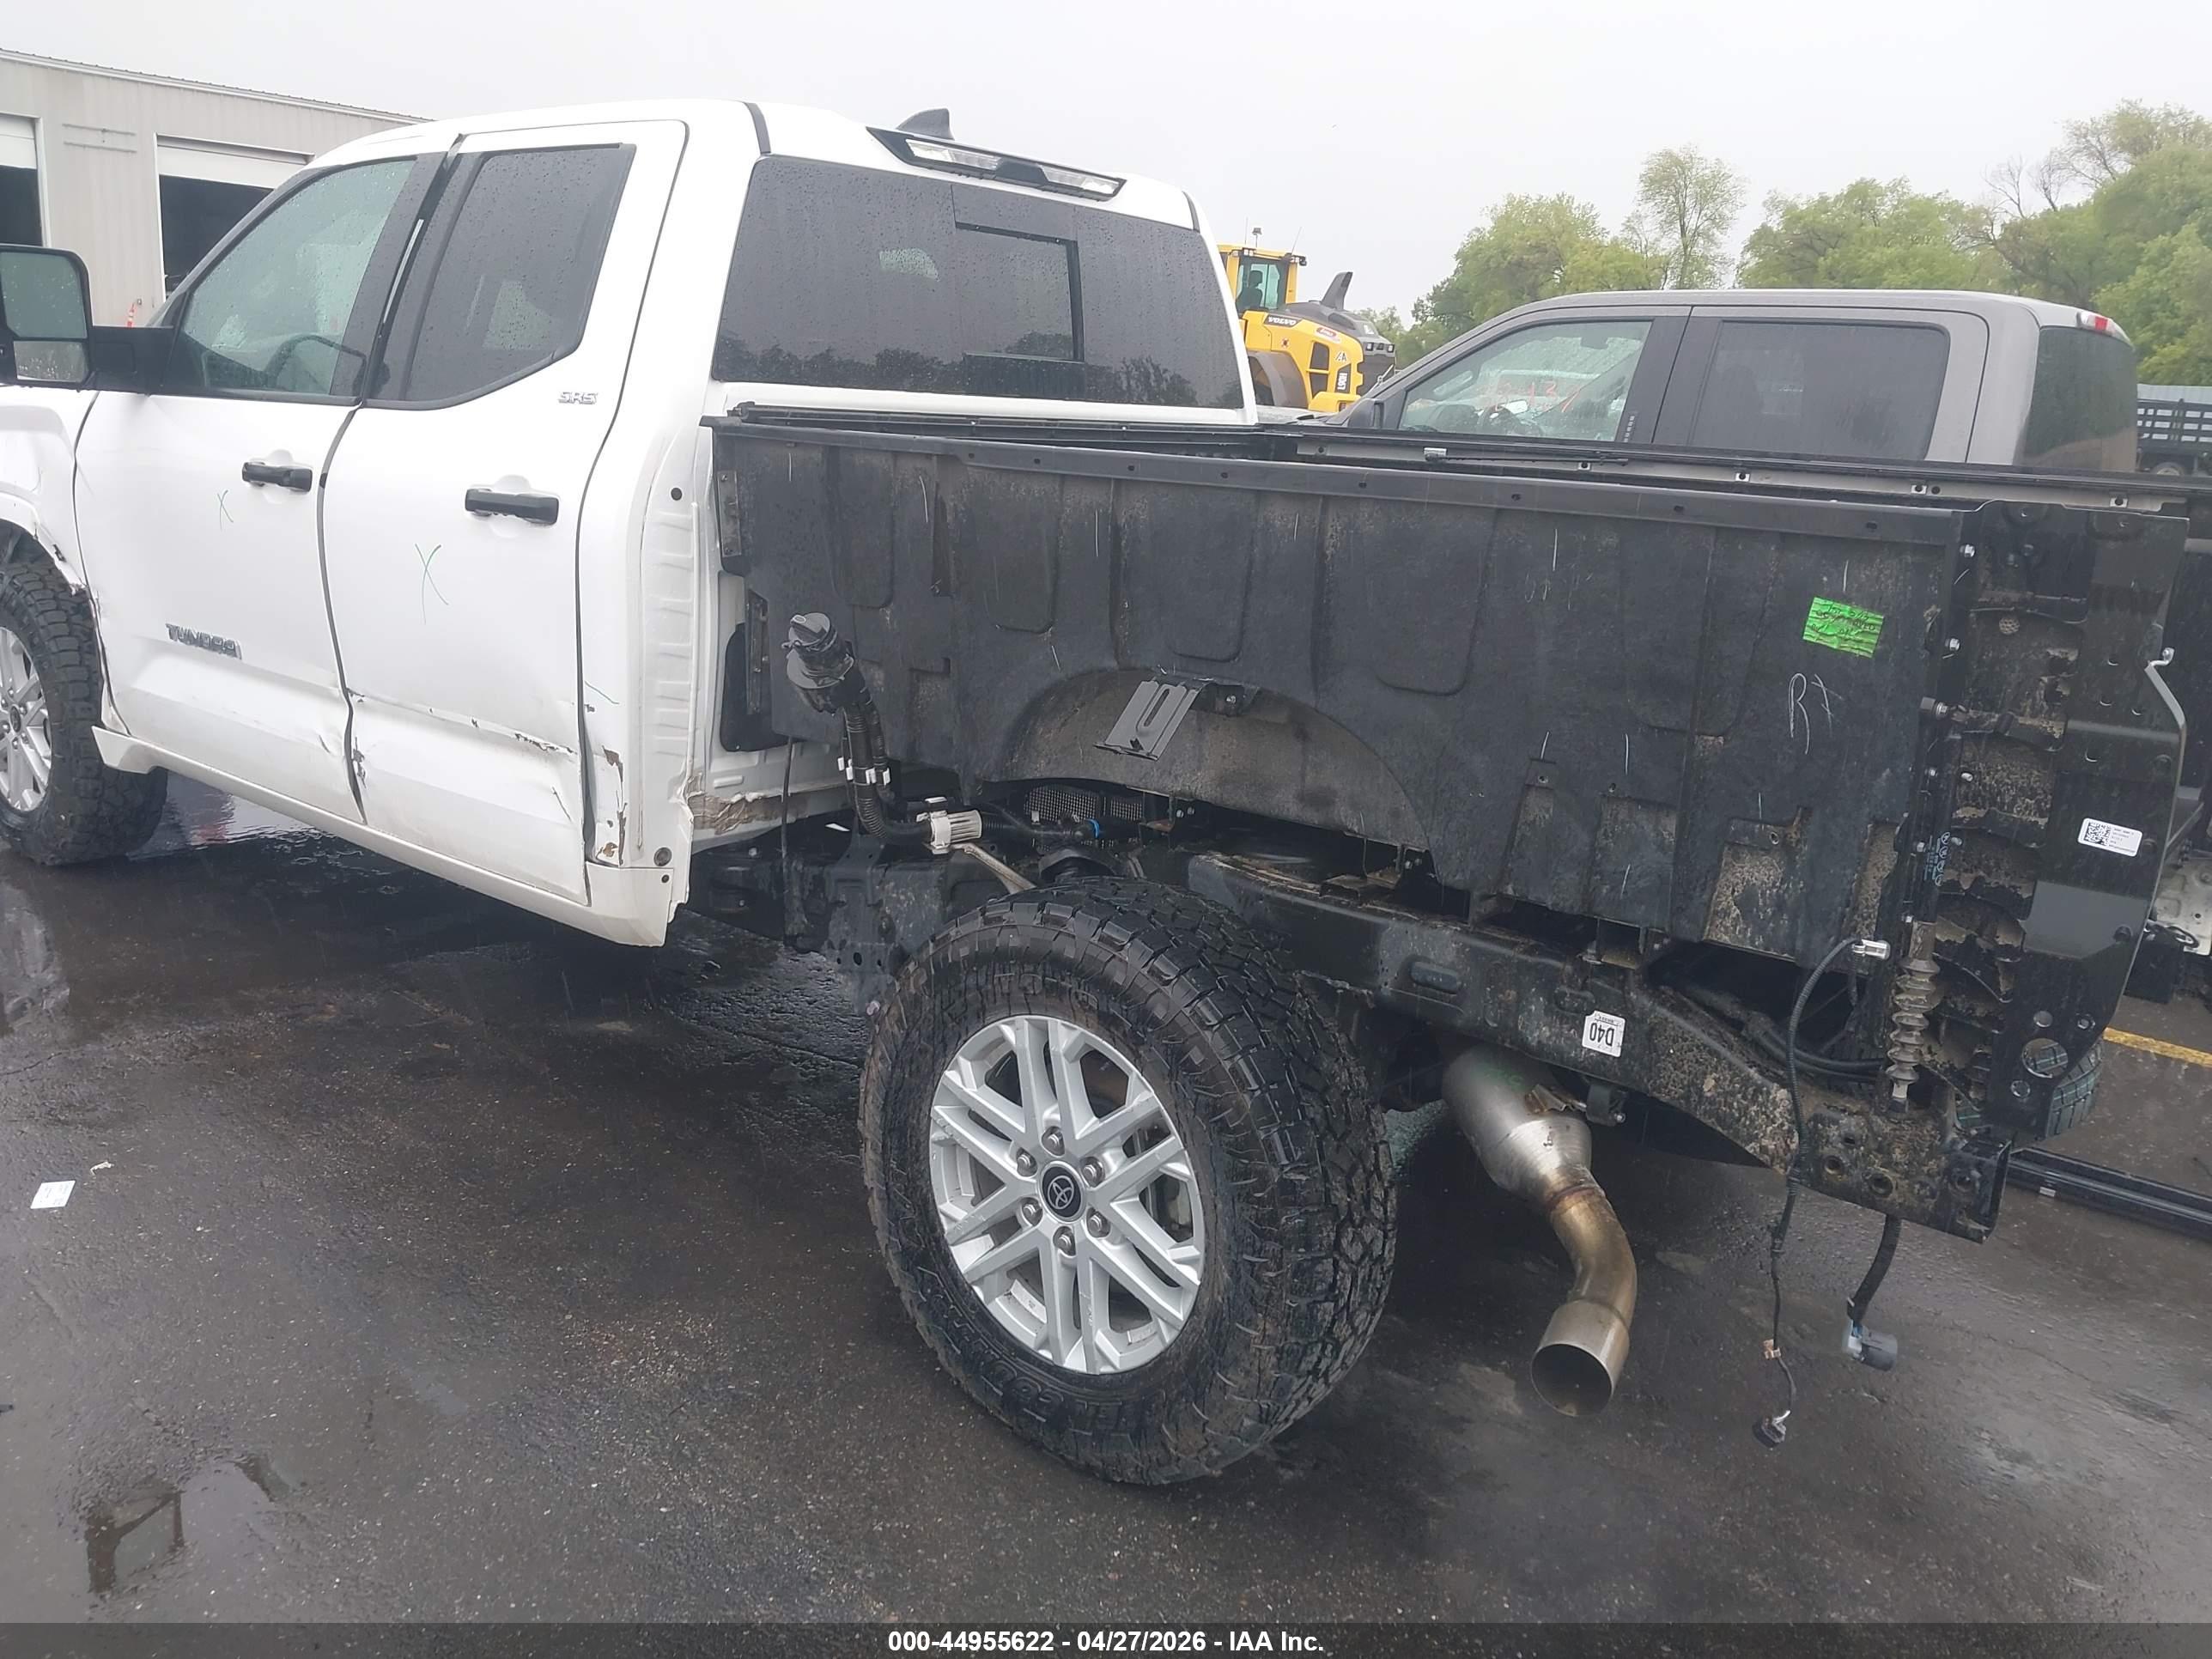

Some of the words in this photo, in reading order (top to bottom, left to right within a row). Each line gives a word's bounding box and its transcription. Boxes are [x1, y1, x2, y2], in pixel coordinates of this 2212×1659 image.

[1267, 316, 1297, 326] VOLVO
[1337, 373, 1347, 390] L90H
[165, 623, 242, 660] TUNDRA
[1589, 1023, 1614, 1047] D40
